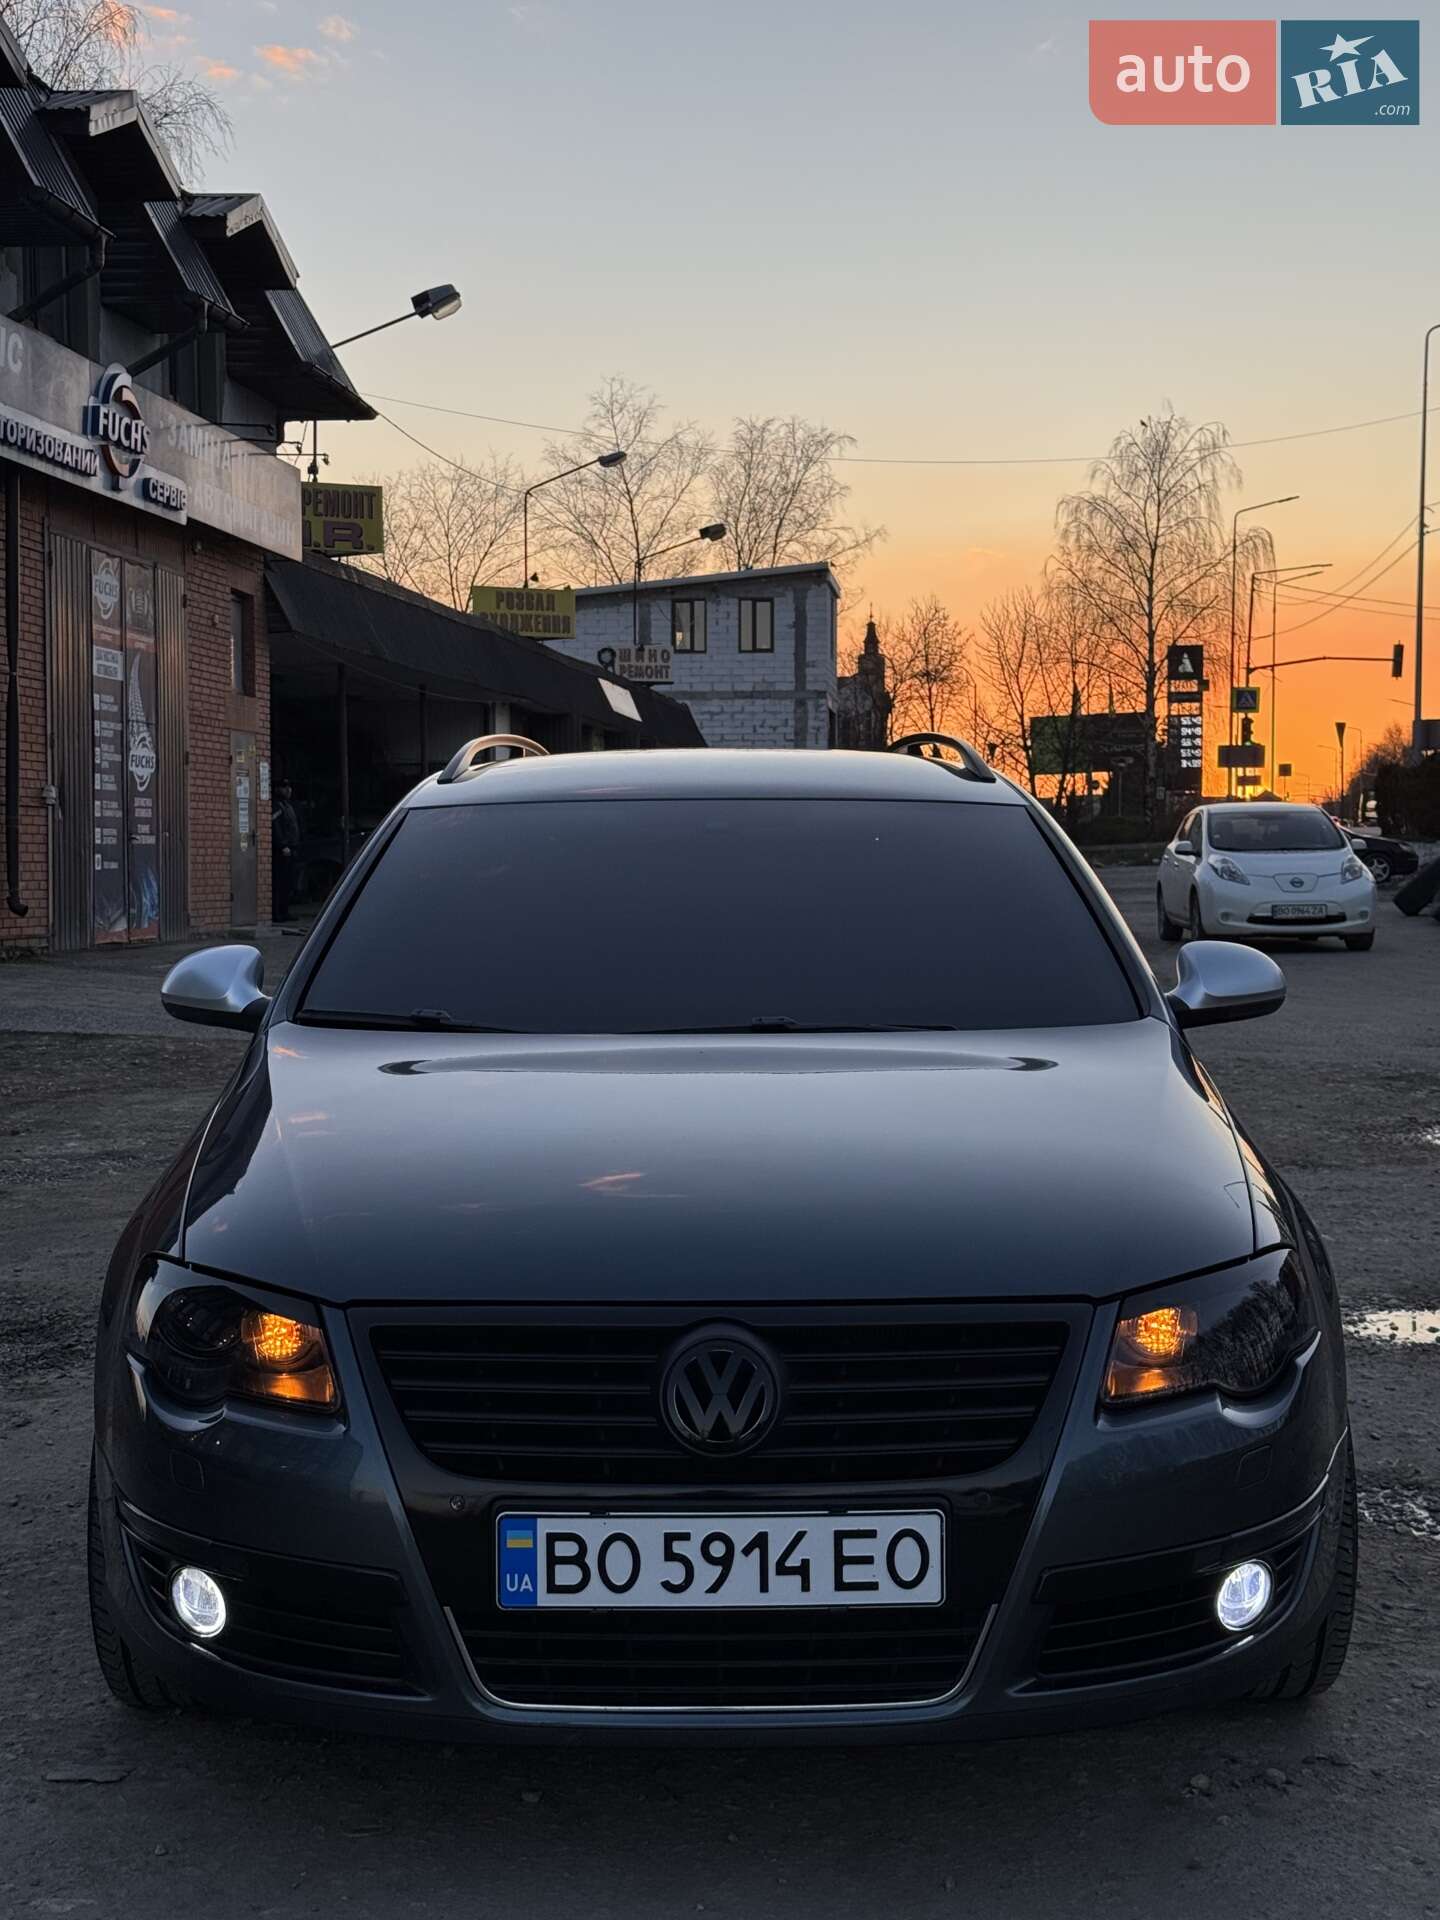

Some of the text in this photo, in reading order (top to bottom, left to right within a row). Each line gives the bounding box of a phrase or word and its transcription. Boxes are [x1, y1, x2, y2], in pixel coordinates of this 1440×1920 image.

[99, 405, 151, 456] FUCHS
[303, 488, 377, 520] РЕМОНТ
[496, 590, 556, 612] РОЗВАЛ
[130, 753, 155, 769] FUCHS
[545, 1528, 930, 1594] BO 5914 EO
[506, 1573, 533, 1592] UA
